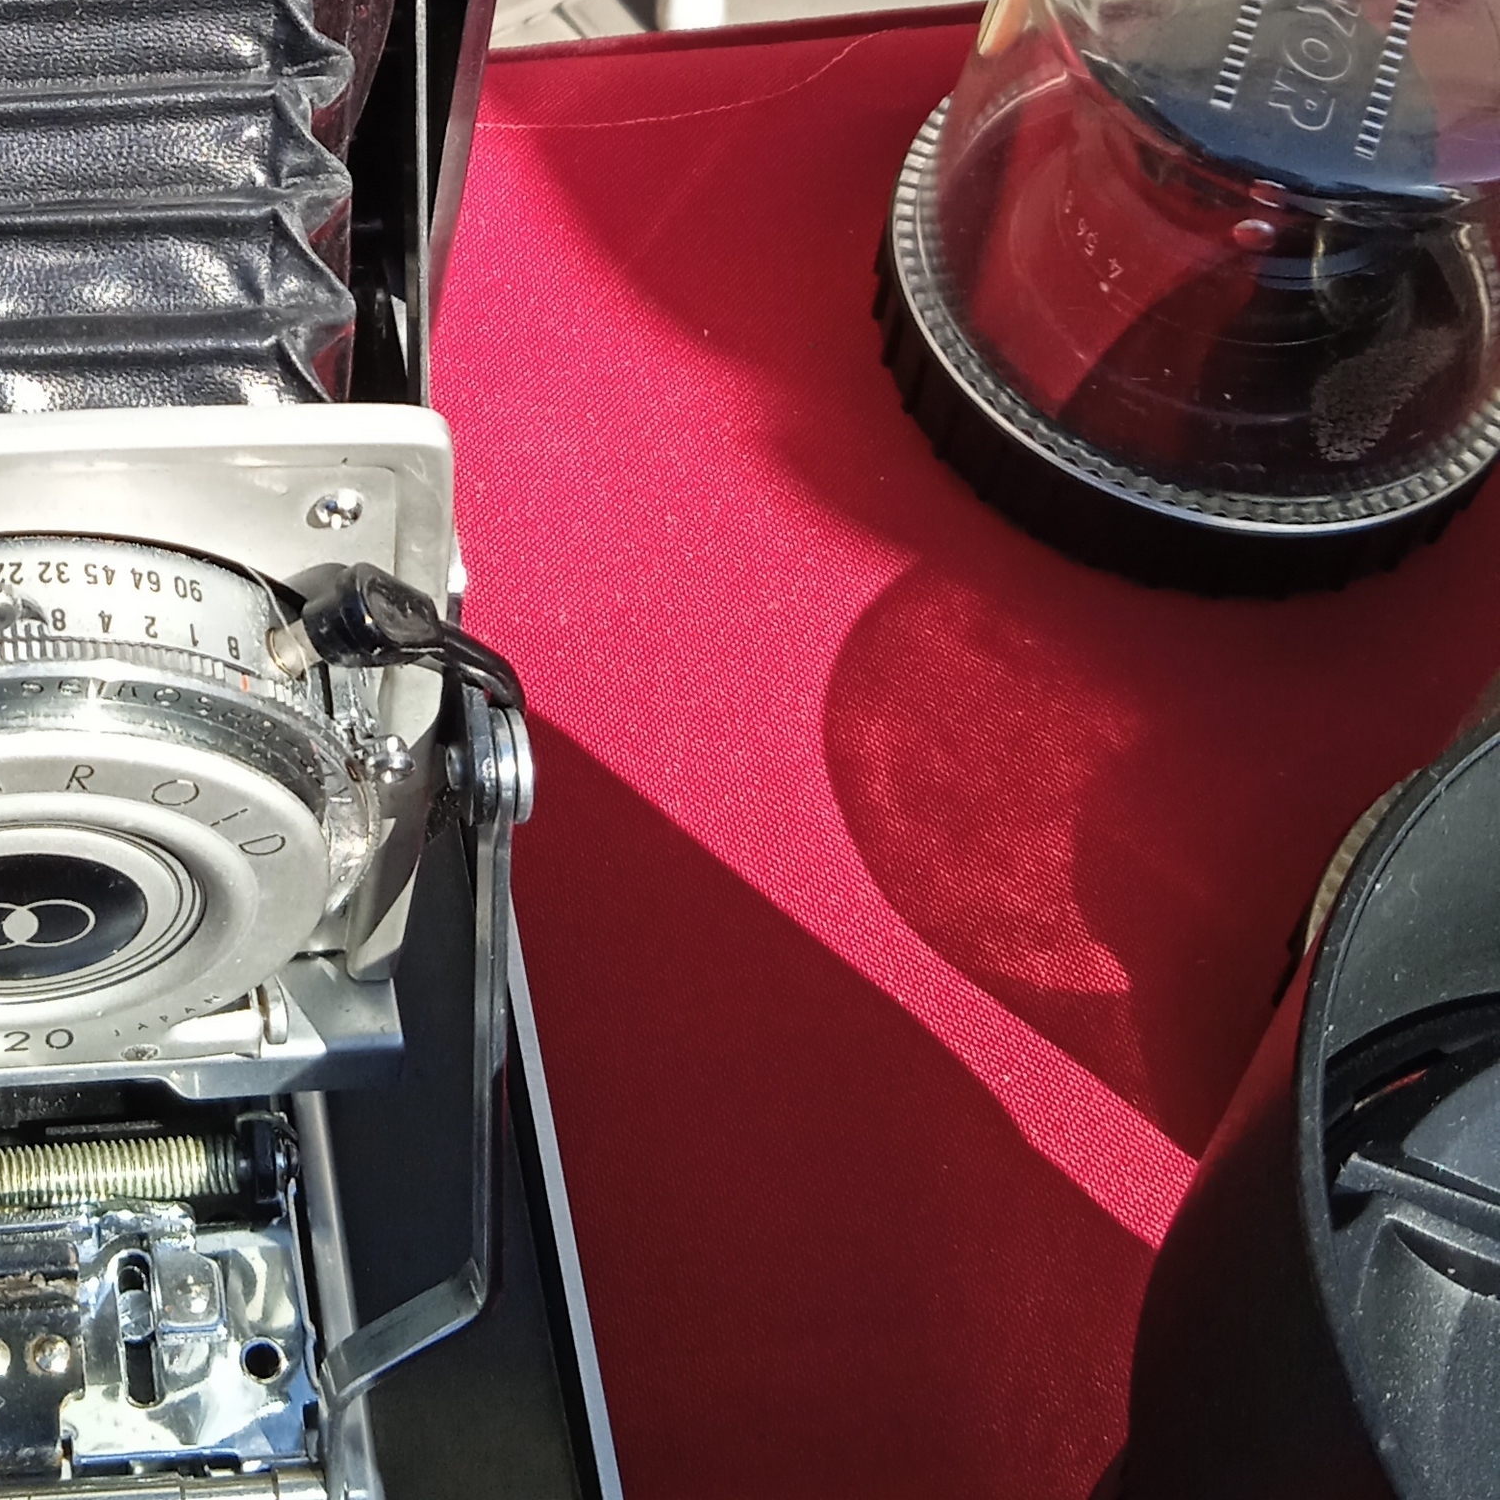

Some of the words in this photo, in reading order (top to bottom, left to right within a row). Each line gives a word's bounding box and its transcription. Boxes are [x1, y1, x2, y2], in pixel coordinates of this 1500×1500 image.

[38, 561, 71, 584] 32
[83, 562, 116, 586] 45
[131, 567, 161, 592] 64
[174, 575, 203, 602] 90
[51, 608, 67, 631] 8
[98, 610, 113, 634] 4
[144, 615, 158, 639] 2
[189, 623, 200, 647] 1
[227, 635, 240, 660] B
[114, 992, 222, 1037] JAPAN
